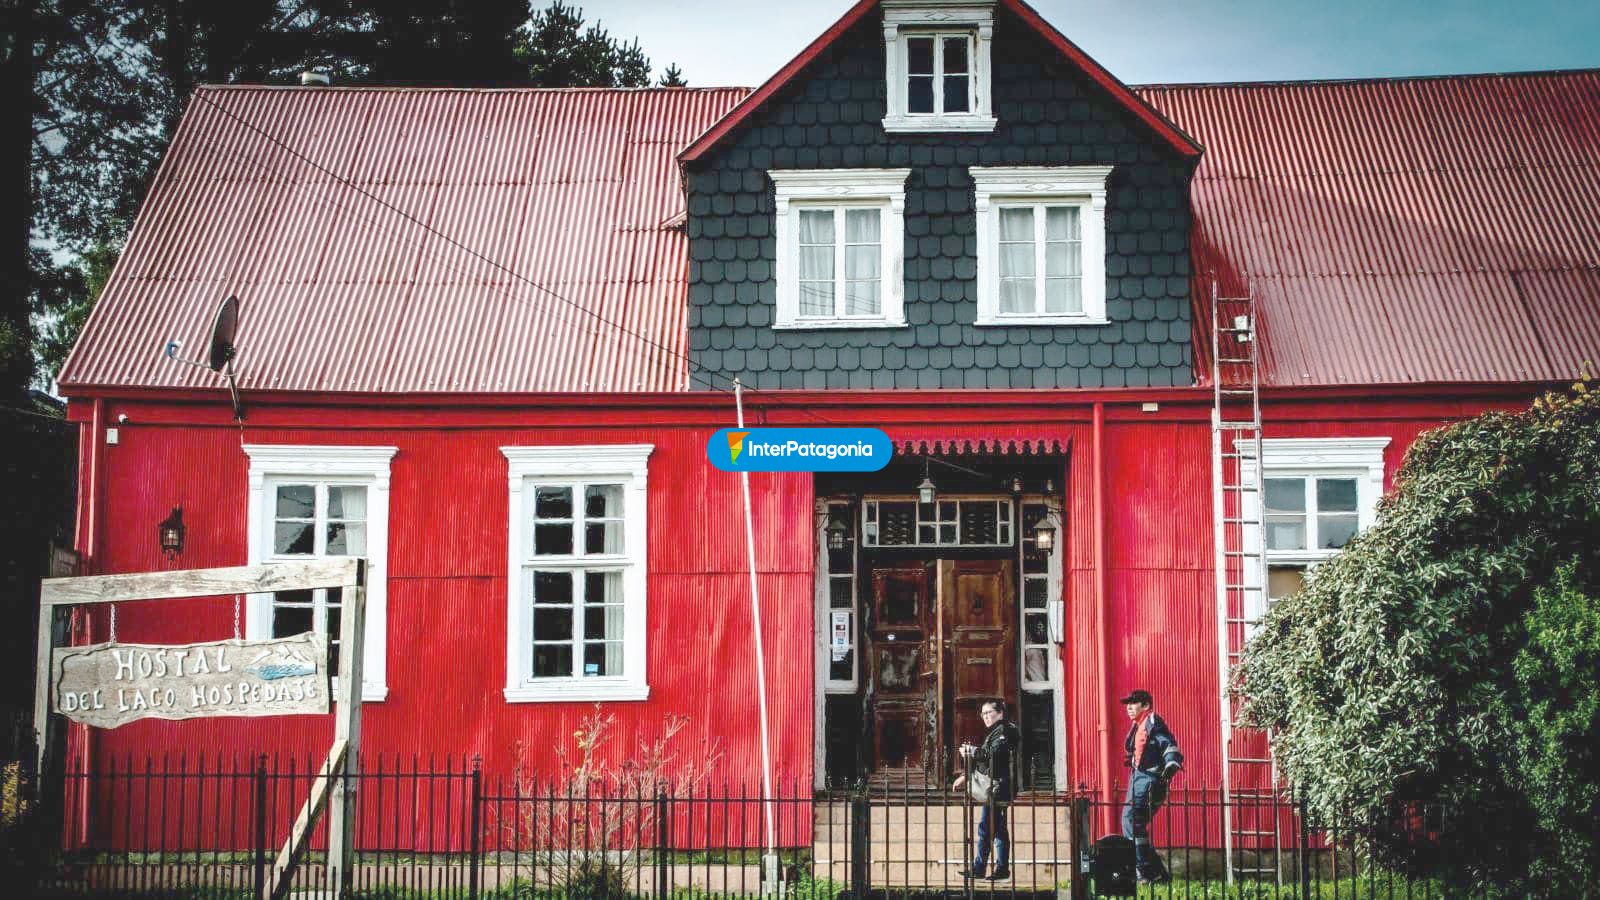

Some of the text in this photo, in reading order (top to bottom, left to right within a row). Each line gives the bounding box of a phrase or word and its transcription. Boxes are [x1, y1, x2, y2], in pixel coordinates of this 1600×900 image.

[114, 648, 232, 680] HOSTAL
[65, 691, 105, 712] DEL
[191, 679, 317, 708] HOSPEDAJE
